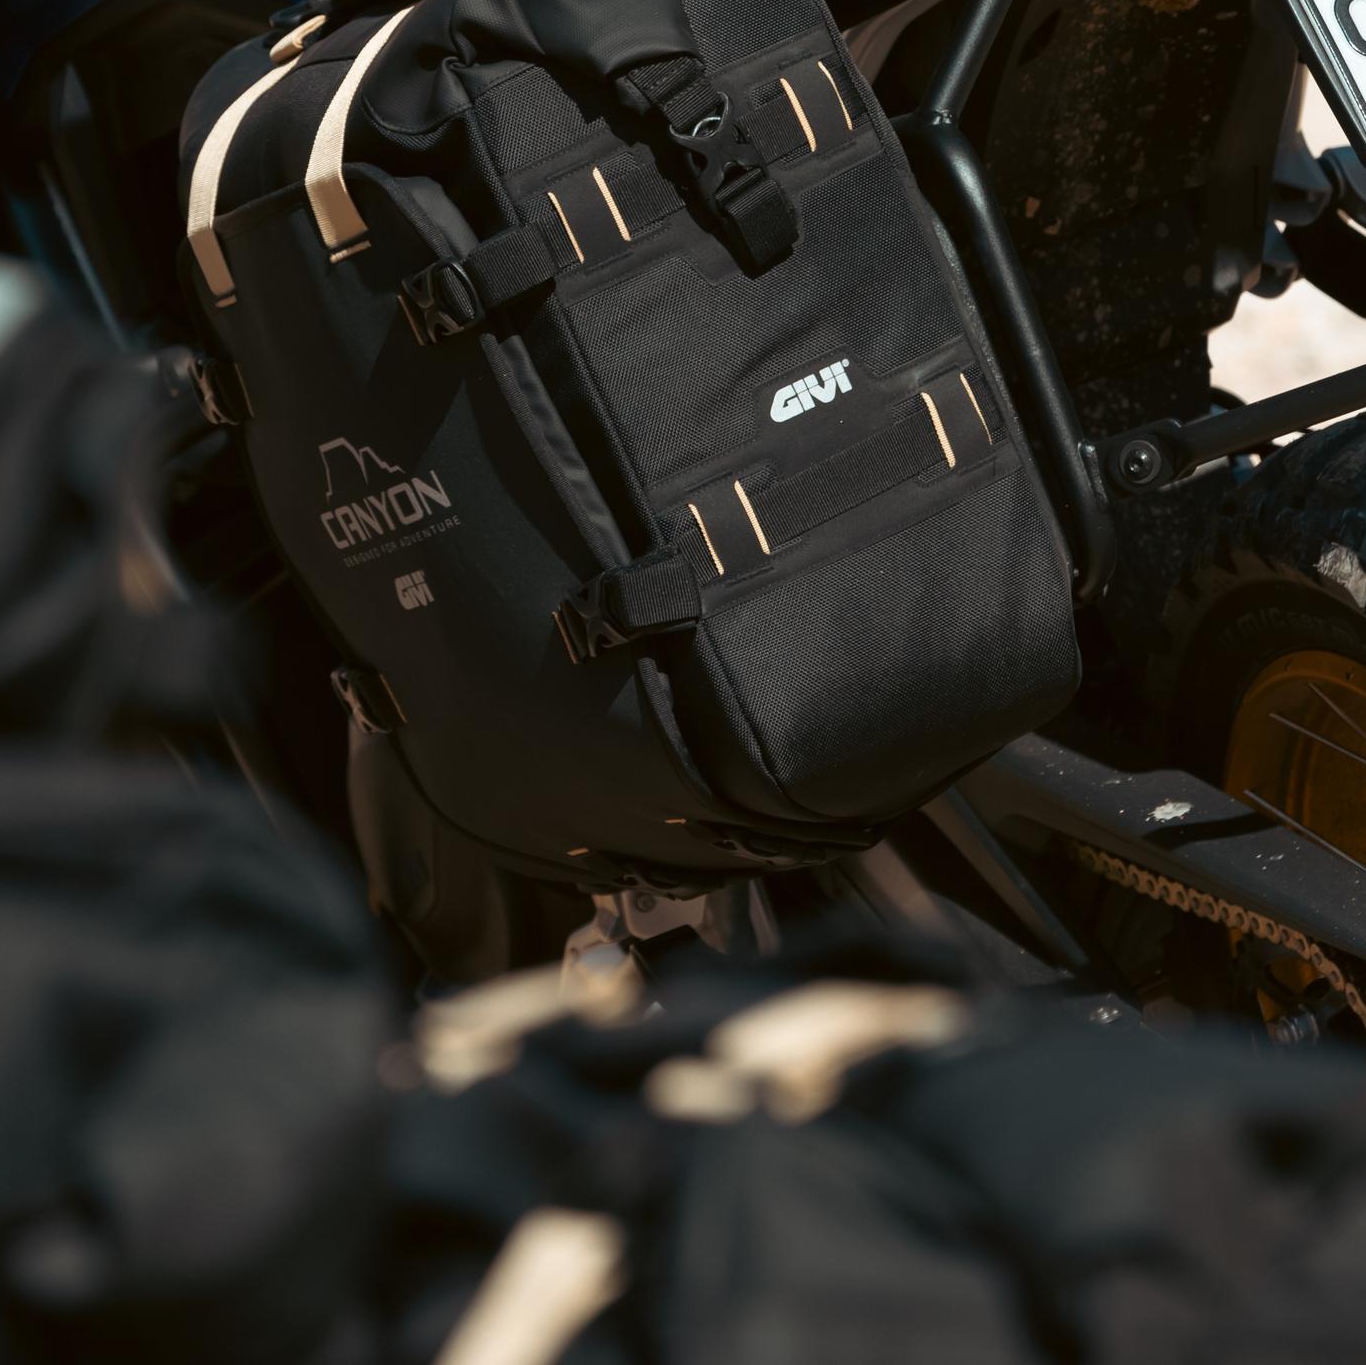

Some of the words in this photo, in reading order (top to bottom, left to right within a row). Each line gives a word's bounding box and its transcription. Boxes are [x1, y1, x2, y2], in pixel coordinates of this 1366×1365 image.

[769, 360, 853, 423] GIVI
[320, 469, 452, 550] CANYON
[398, 514, 462, 547] ADVENTURE
